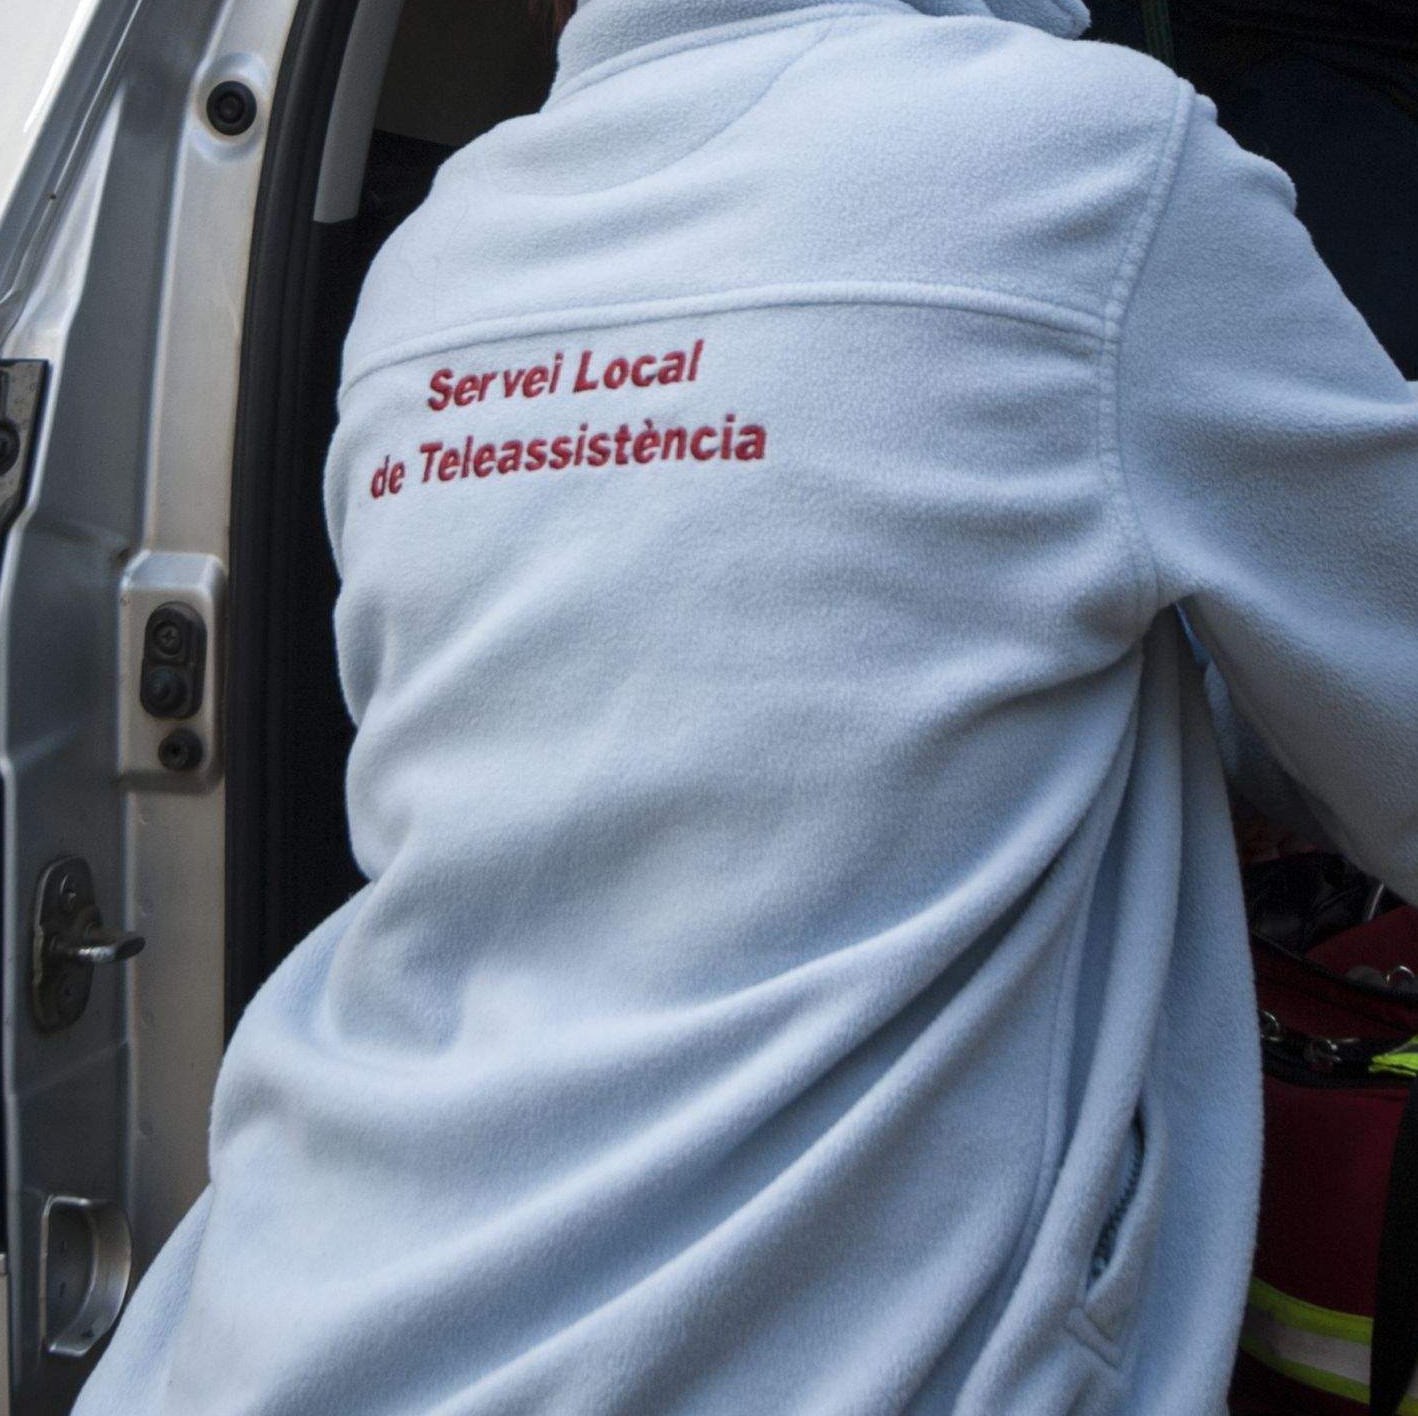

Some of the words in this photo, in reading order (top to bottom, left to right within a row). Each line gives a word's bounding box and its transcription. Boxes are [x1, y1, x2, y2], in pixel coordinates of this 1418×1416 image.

[428, 353, 564, 411] Servei
[573, 339, 704, 393] Local
[370, 456, 405, 498] de
[419, 414, 767, 484] Teleassistència
